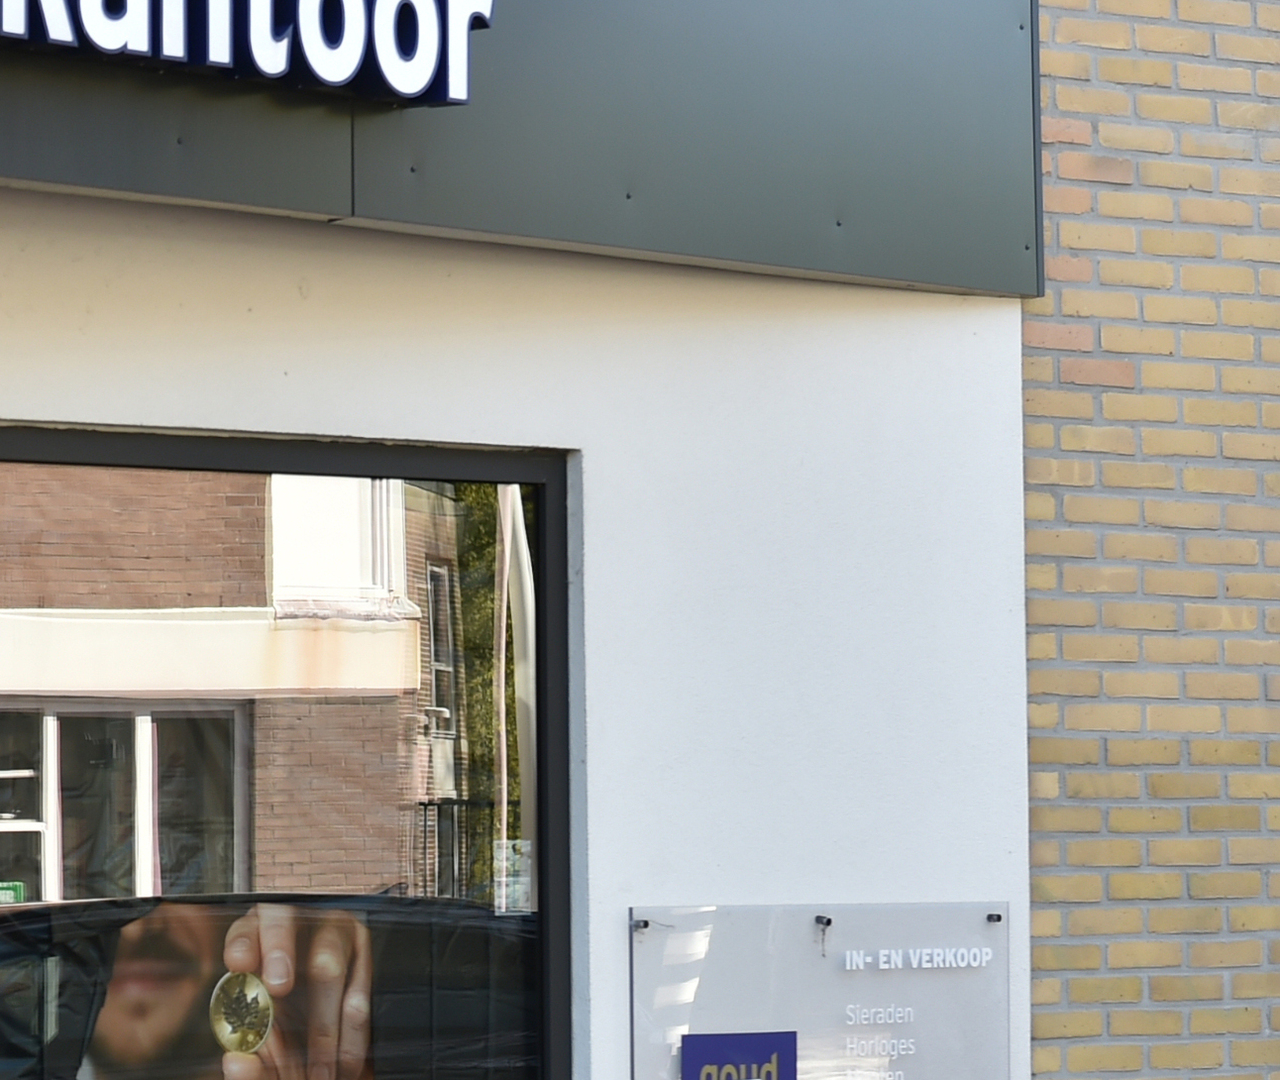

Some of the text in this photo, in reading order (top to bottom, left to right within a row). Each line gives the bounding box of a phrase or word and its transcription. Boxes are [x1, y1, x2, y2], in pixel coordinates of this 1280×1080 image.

[845, 947, 993, 970] IN- EN VERKOOP
[845, 1004, 914, 1025] Sieraden
[846, 1036, 916, 1060] Horloges
